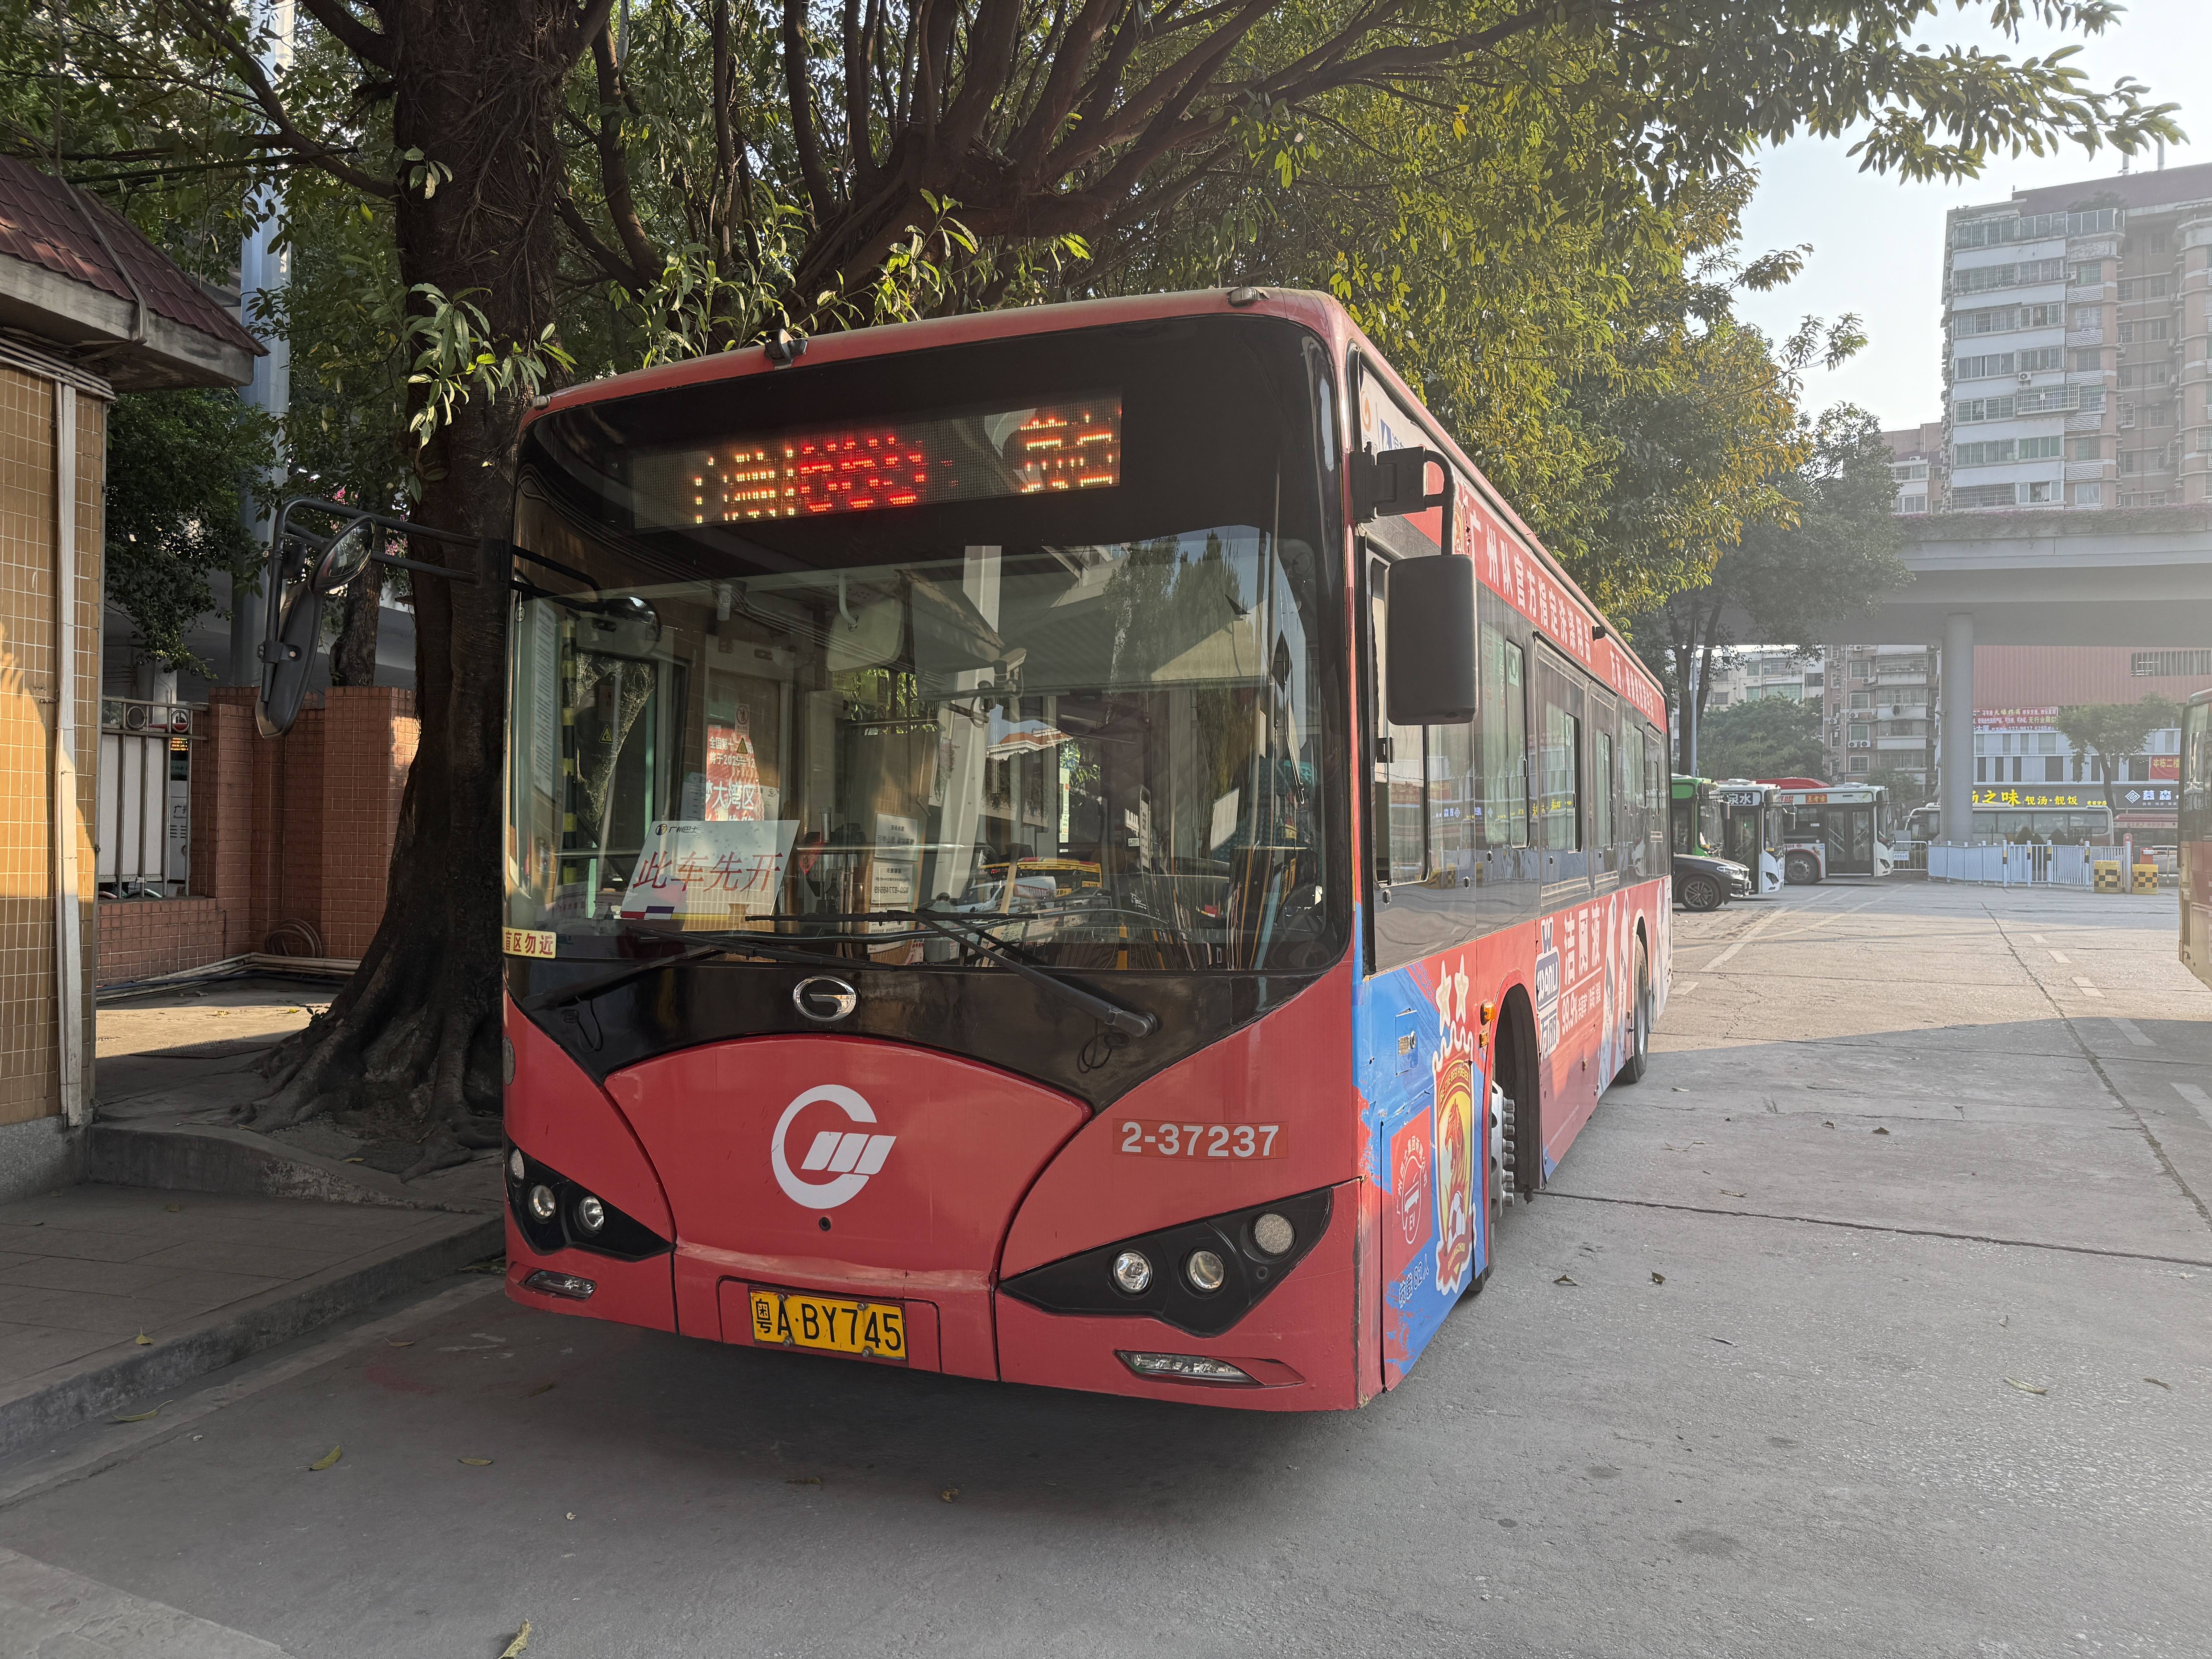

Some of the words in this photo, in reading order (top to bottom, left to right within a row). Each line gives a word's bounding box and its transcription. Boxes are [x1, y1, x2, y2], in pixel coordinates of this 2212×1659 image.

[1470, 509, 1591, 664] 广州队官方指定洗涤用品
[1722, 793, 1752, 804] 泉水
[2024, 795, 2078, 805] 靓汤·靓饭
[632, 850, 783, 892] 此车先开
[505, 930, 553, 955] 盲区勿近
[1564, 902, 1600, 986] 洁厕液
[1121, 1122, 1279, 1157] 2-37237
[1410, 1211, 1415, 1231] EV
[1448, 1242, 1465, 1271] GUANGZHOU
[756, 1298, 902, 1351] 粤A·BY745
